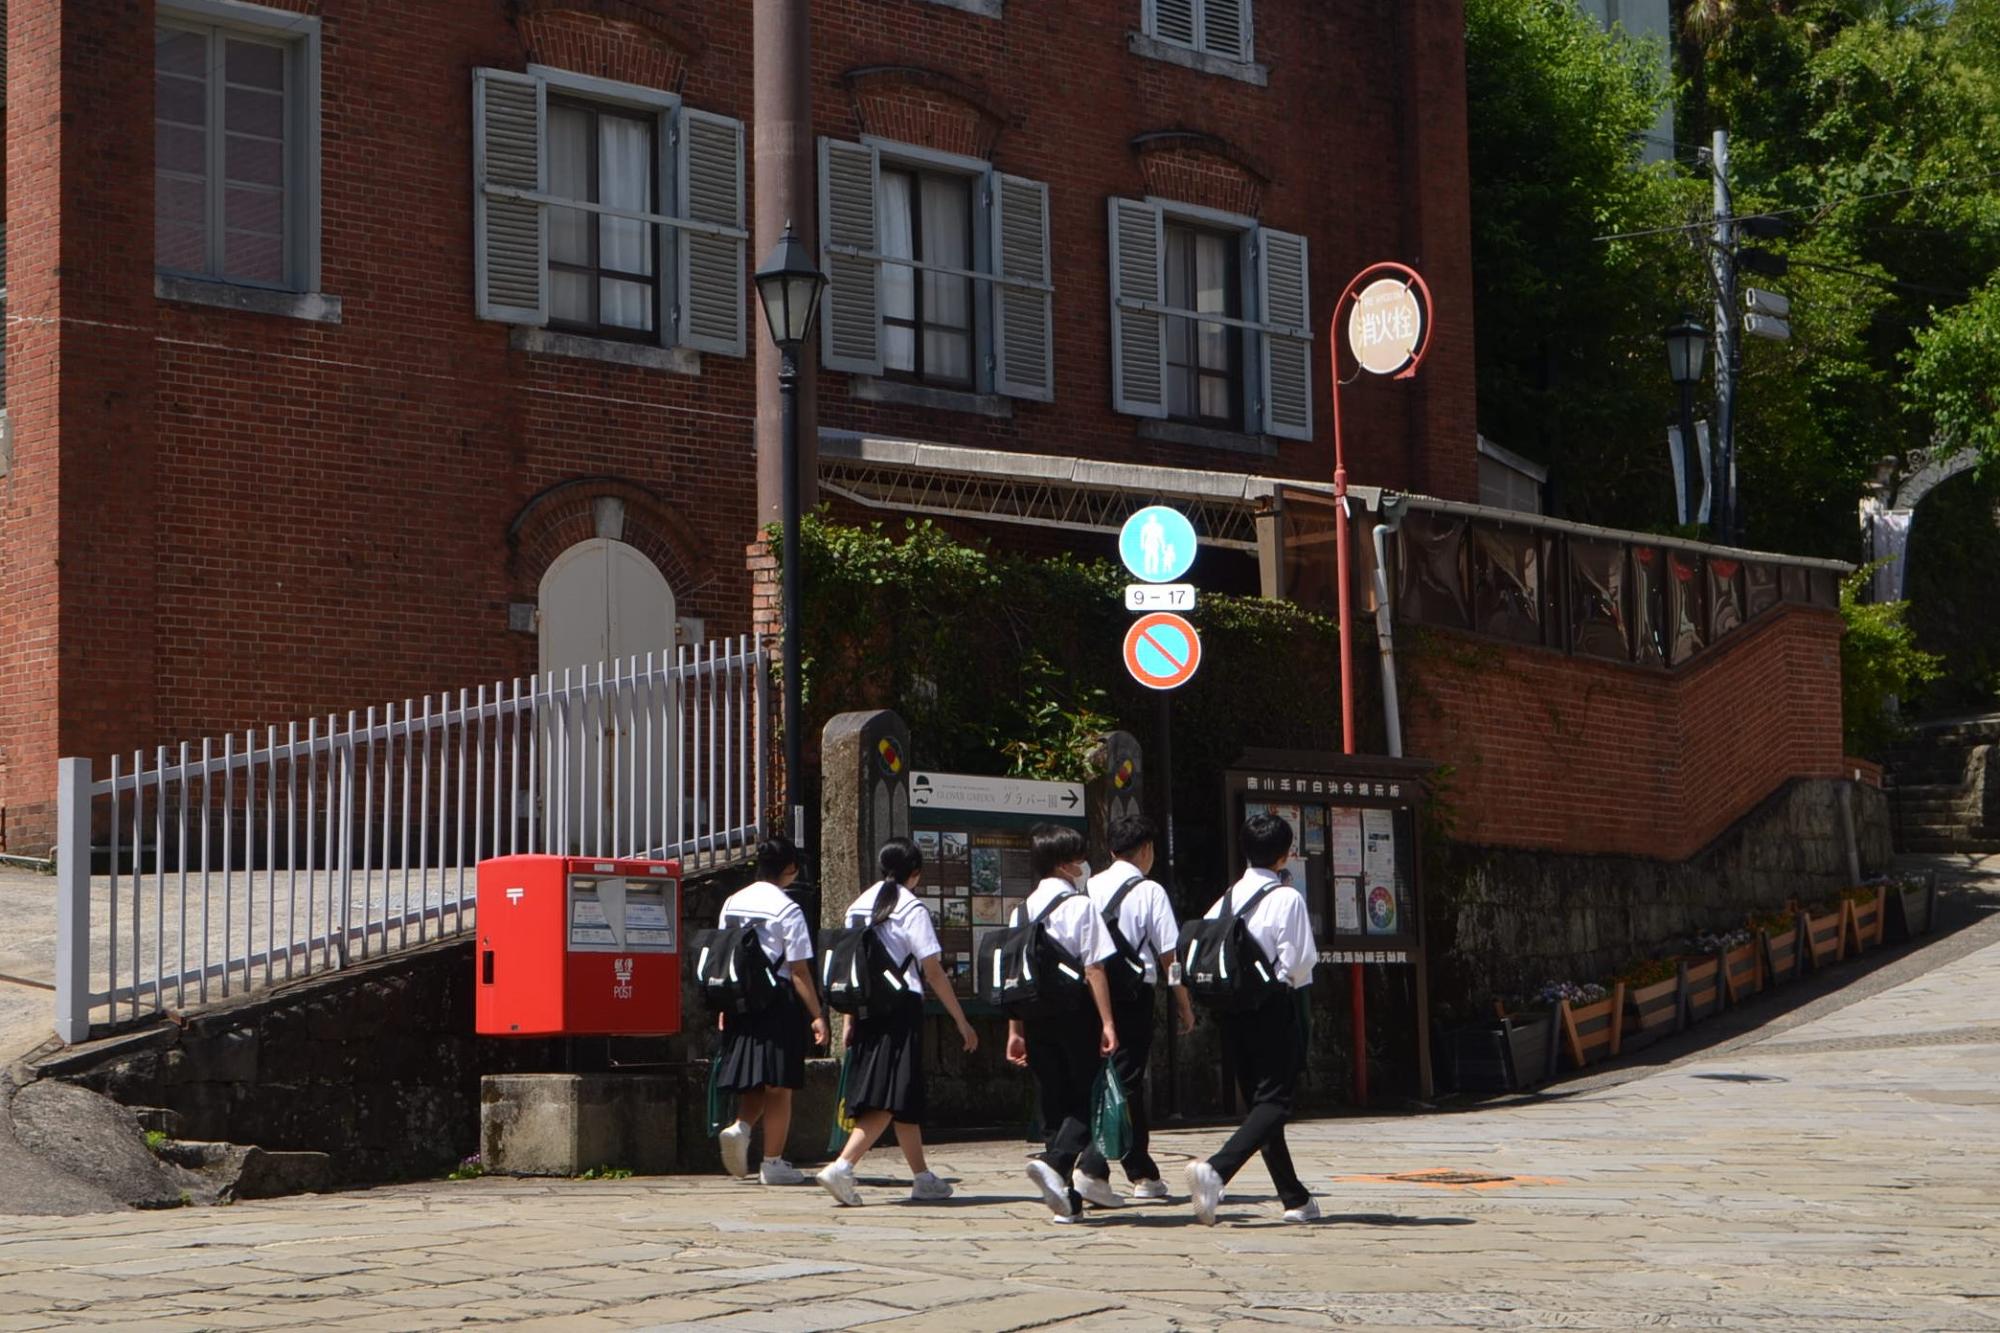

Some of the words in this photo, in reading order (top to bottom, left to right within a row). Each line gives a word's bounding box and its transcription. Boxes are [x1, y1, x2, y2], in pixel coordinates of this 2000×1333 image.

[1357, 305, 1413, 347] 消火栓
[613, 985, 632, 999] POST
